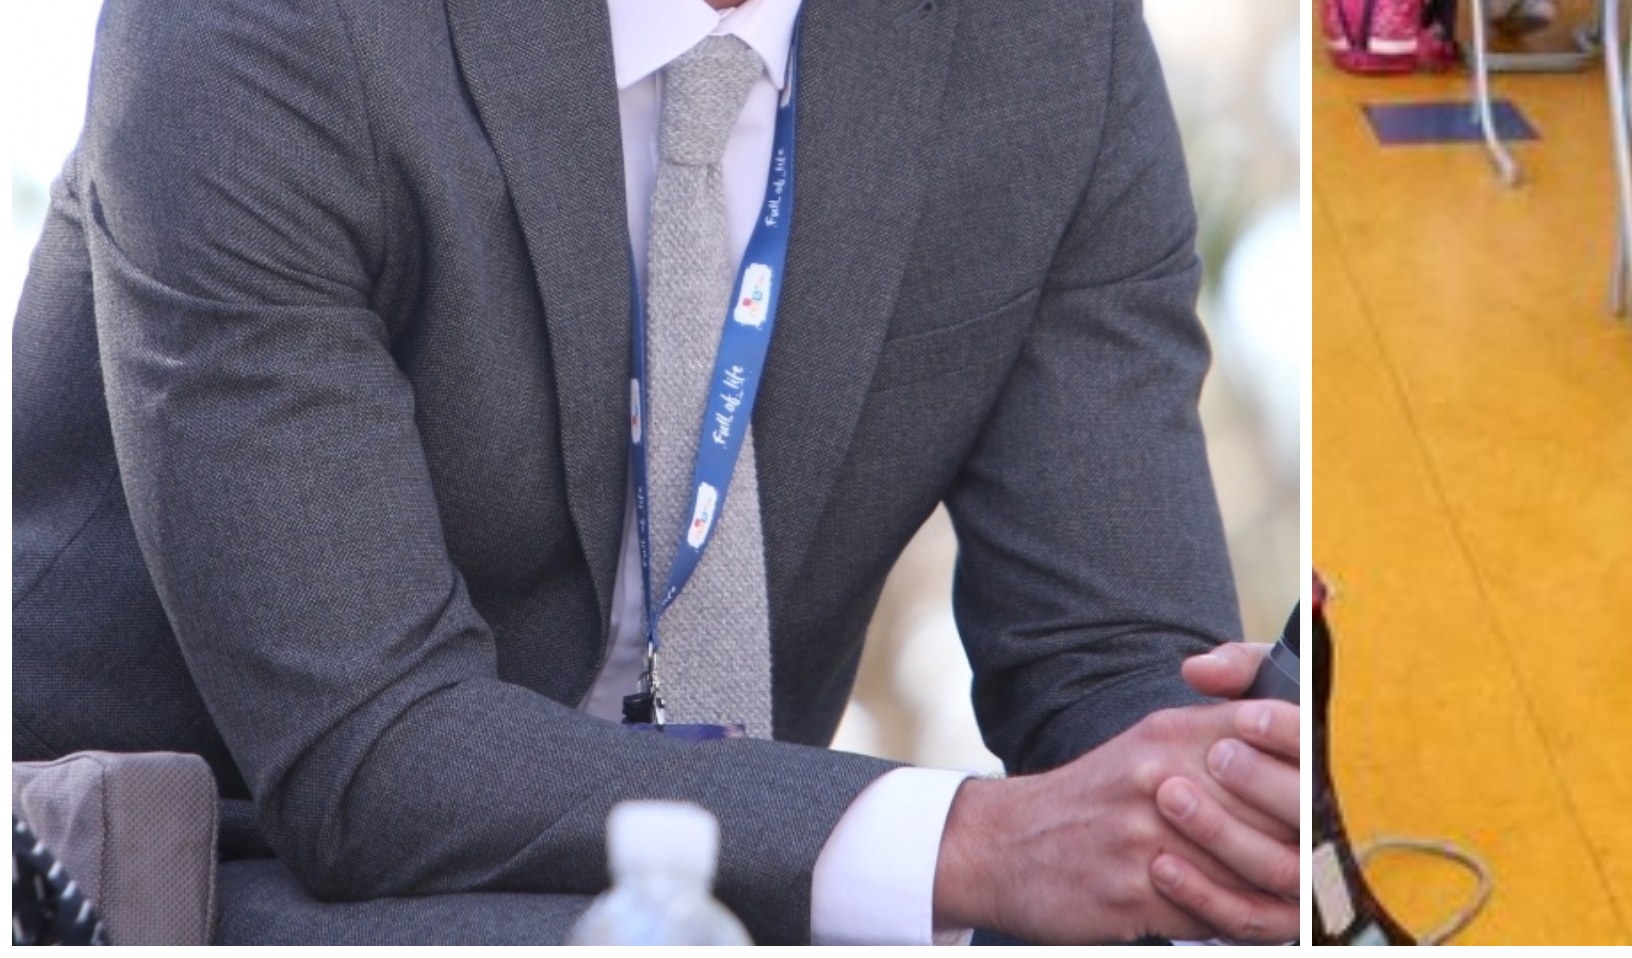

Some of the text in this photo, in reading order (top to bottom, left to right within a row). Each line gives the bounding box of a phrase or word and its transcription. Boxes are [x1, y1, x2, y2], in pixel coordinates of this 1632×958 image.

[712, 365, 746, 445] Full of life
